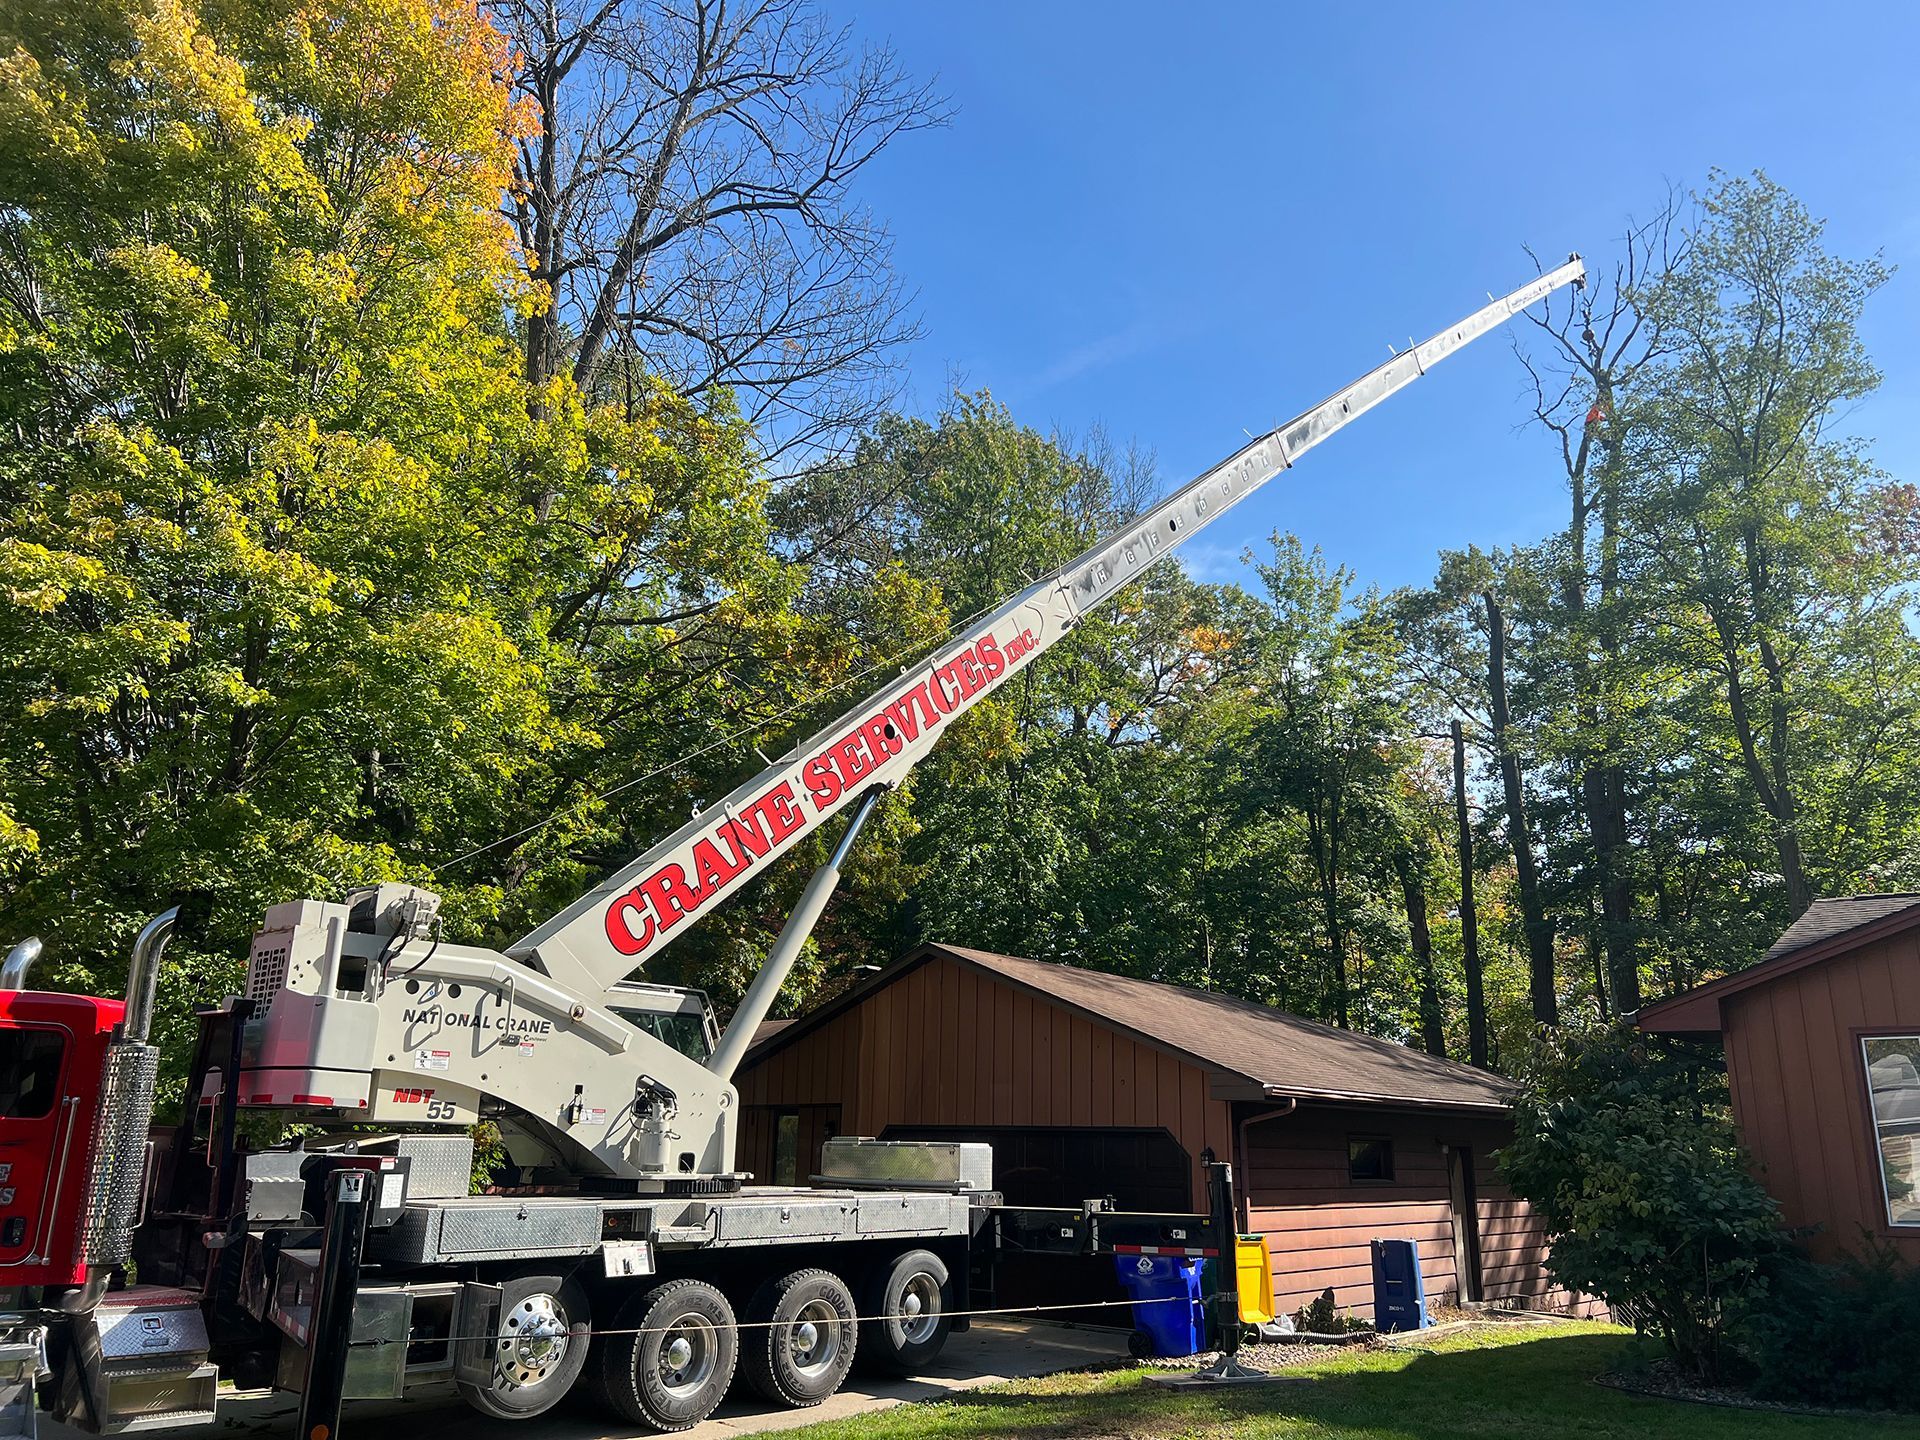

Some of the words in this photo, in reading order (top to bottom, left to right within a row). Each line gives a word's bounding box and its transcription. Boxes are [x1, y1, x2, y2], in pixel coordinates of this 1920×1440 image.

[604, 781, 807, 956] CRANE
[801, 633, 1006, 812] SERVICES
[1003, 629, 1041, 667] INC.
[402, 1008, 491, 1030] NATONAL
[495, 1017, 552, 1035] CRANE
[392, 1088, 435, 1104] NBT
[426, 1101, 457, 1120] 55
[819, 1285, 852, 1369] GOODYEAR
